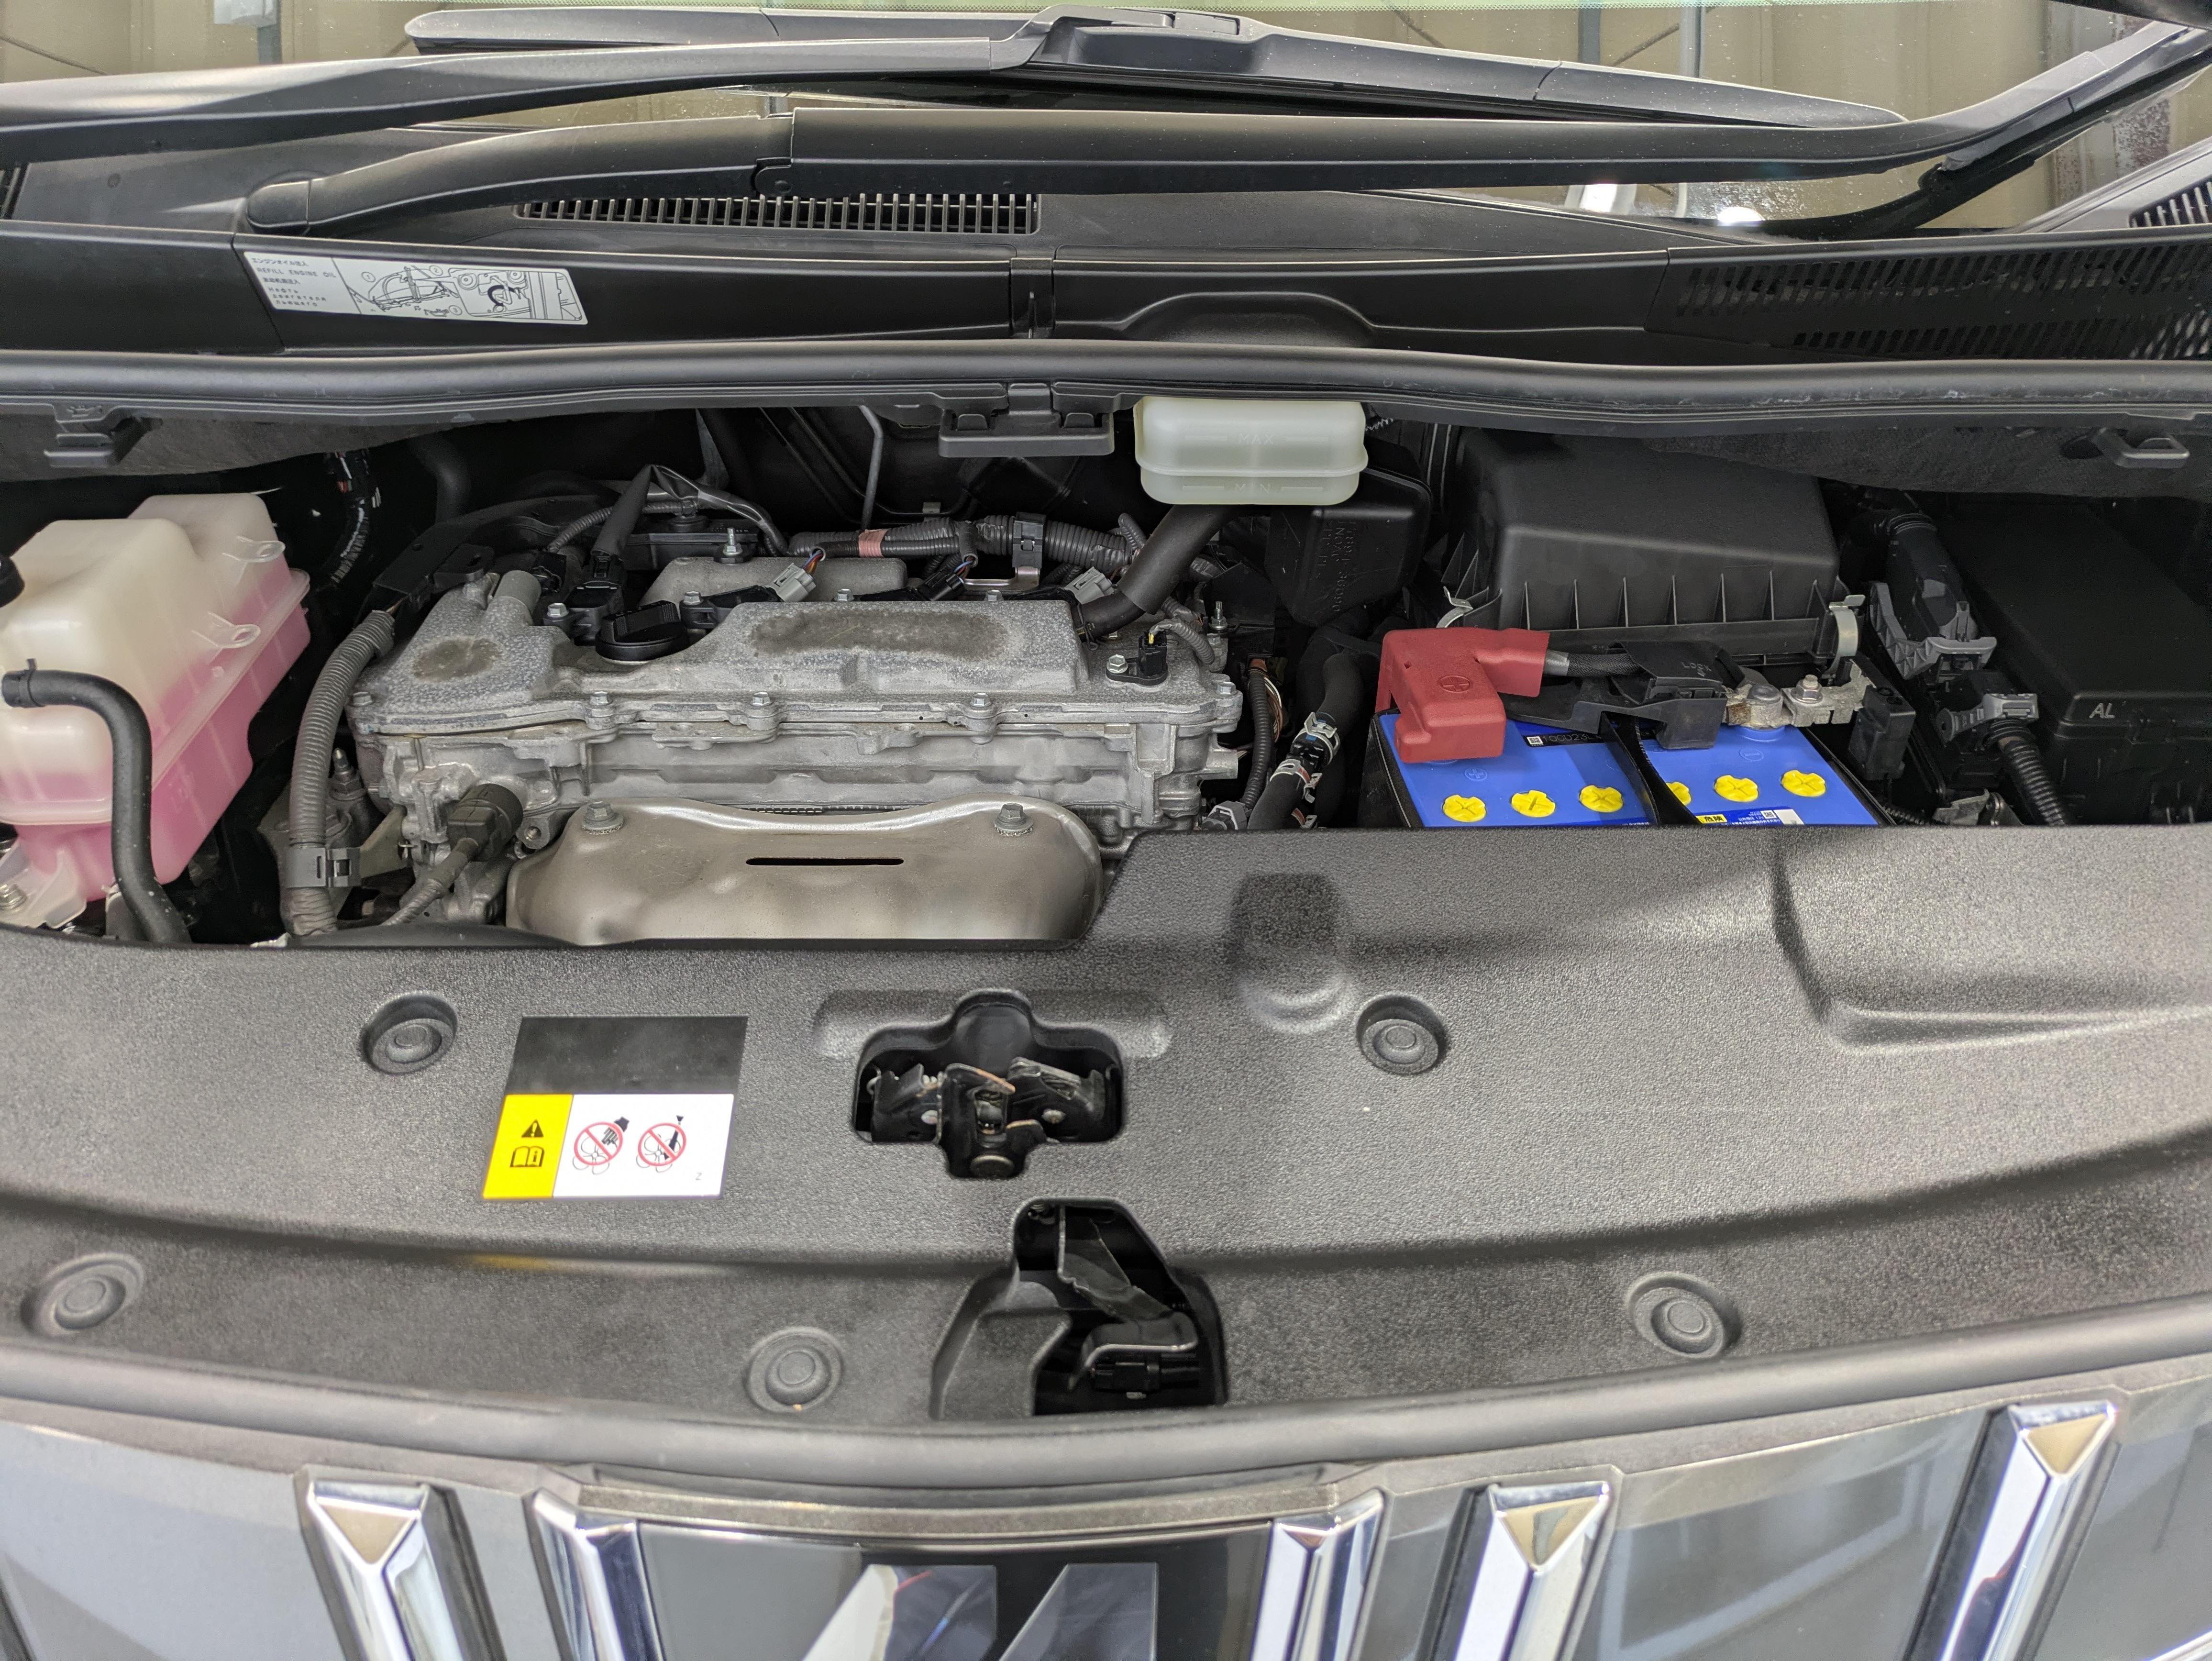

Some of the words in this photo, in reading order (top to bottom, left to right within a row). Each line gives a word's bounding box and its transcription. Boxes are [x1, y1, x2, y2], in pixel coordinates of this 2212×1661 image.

[1239, 433, 1273, 444] MAX
[1235, 483, 1271, 495] MIN
[1680, 662, 1712, 672] LOCK
[2089, 702, 2115, 719] AL
